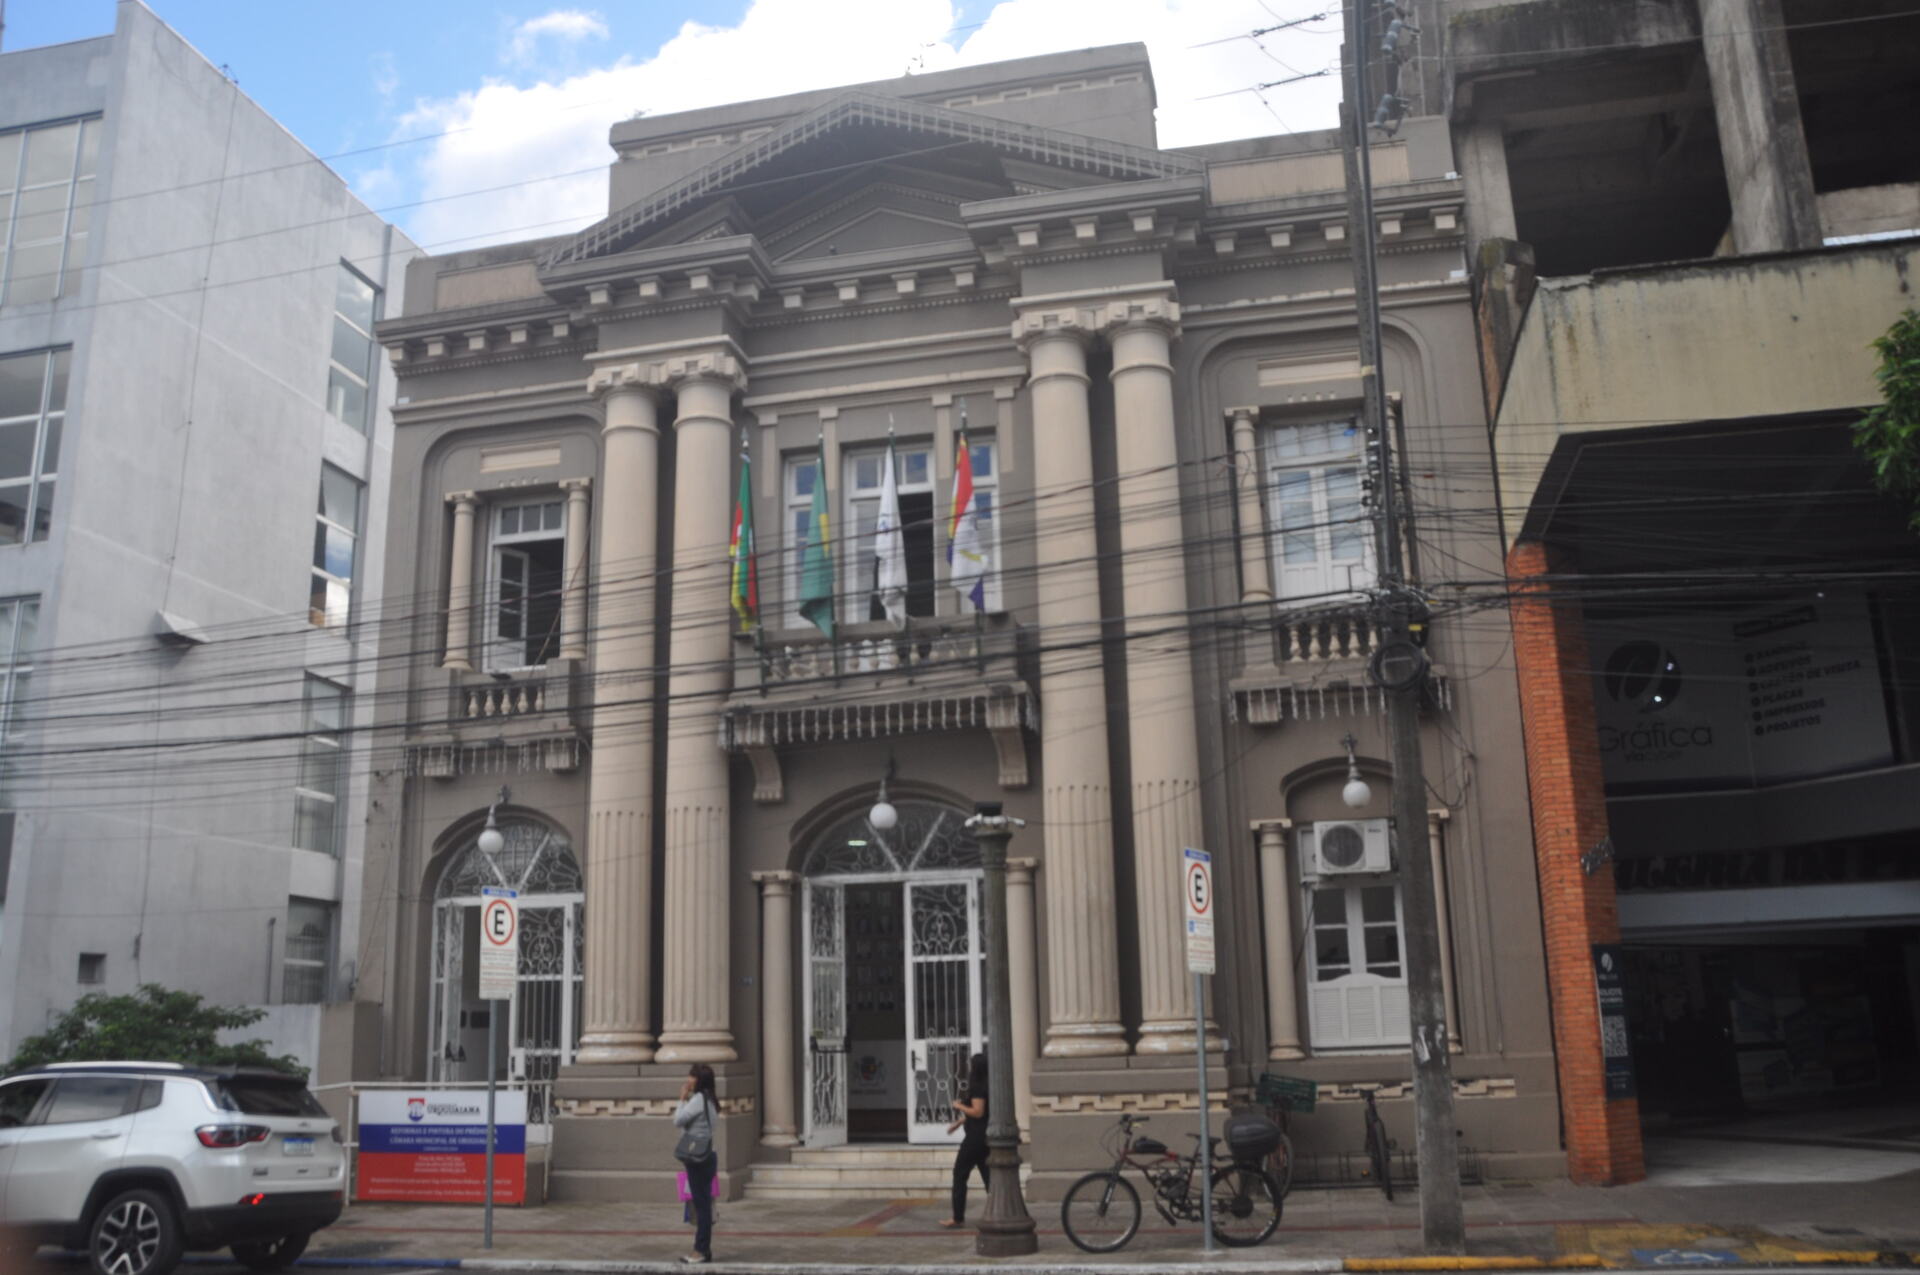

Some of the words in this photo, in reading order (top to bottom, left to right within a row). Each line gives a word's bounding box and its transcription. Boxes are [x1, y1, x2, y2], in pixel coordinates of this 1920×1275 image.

[1763, 688, 1804, 704] PLACAS
[1598, 722, 1713, 752] Gráfica
[1766, 715, 1821, 734] PROJETOS
[1194, 873, 1203, 904] E
[494, 910, 505, 936] E
